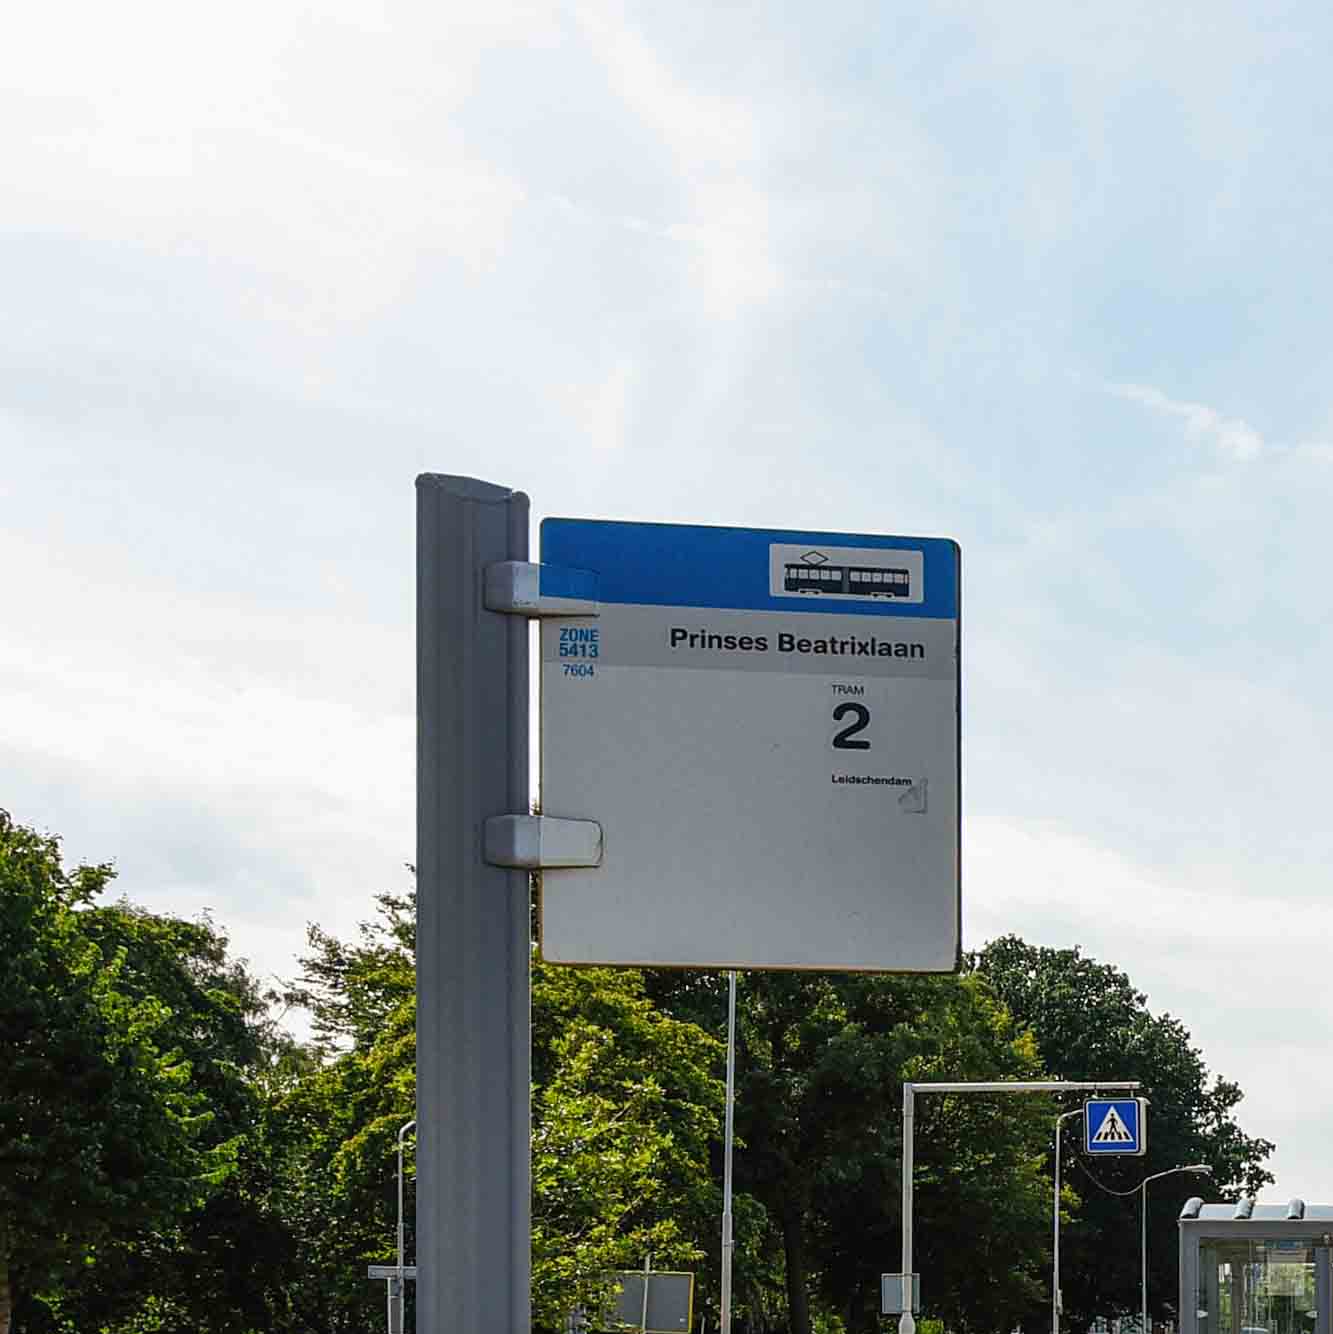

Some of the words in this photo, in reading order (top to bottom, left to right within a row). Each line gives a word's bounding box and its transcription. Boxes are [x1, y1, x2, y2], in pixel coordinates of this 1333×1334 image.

[559, 628, 599, 642] ZONE
[559, 643, 599, 657] 5413
[670, 628, 769, 651] Prinses
[777, 633, 925, 658] Beatrixlaan
[562, 663, 594, 676] 7604
[832, 684, 864, 695] TRAM
[832, 702, 871, 750] 2
[831, 774, 912, 785] Leidschendam
